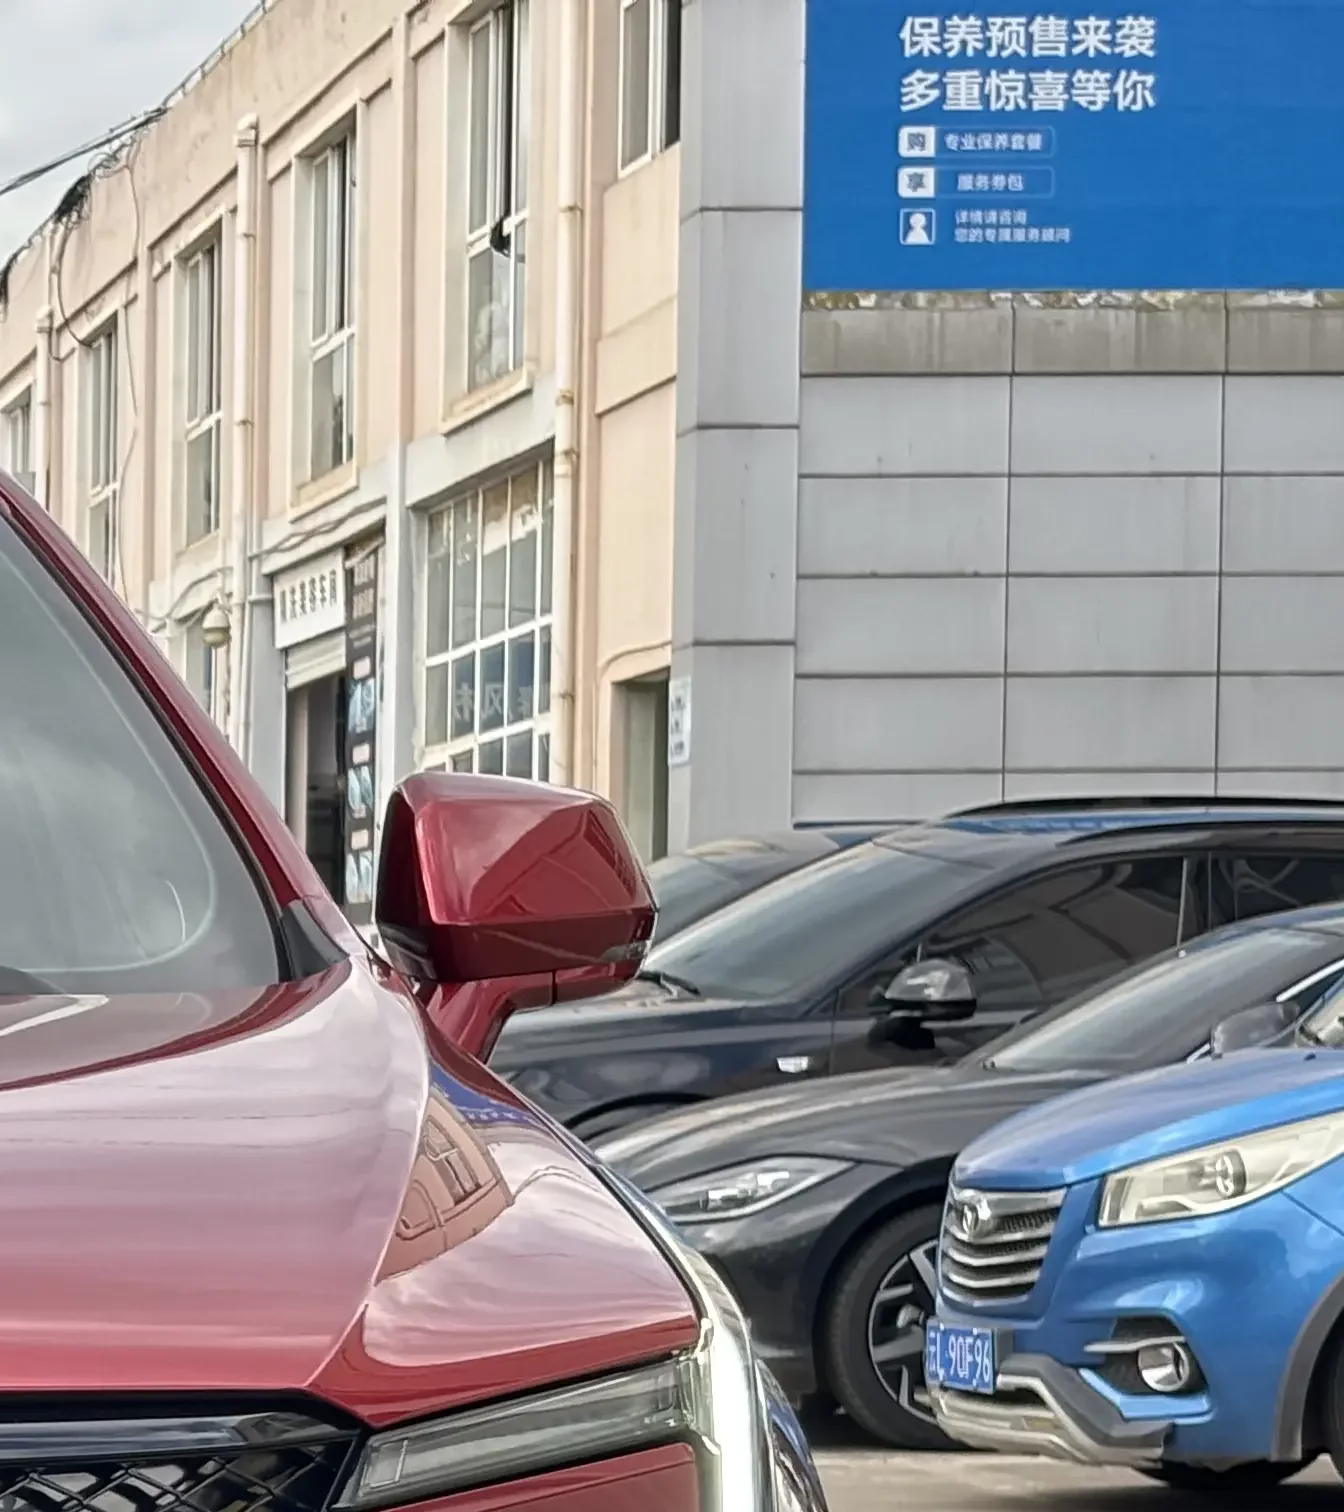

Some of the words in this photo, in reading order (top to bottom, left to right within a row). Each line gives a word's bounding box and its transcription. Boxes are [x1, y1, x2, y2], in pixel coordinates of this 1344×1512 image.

[899, 15, 1156, 58] 保养预售来袭
[899, 69, 1156, 112] 多重惊喜等你
[944, 132, 1043, 151] 专业保养套餐
